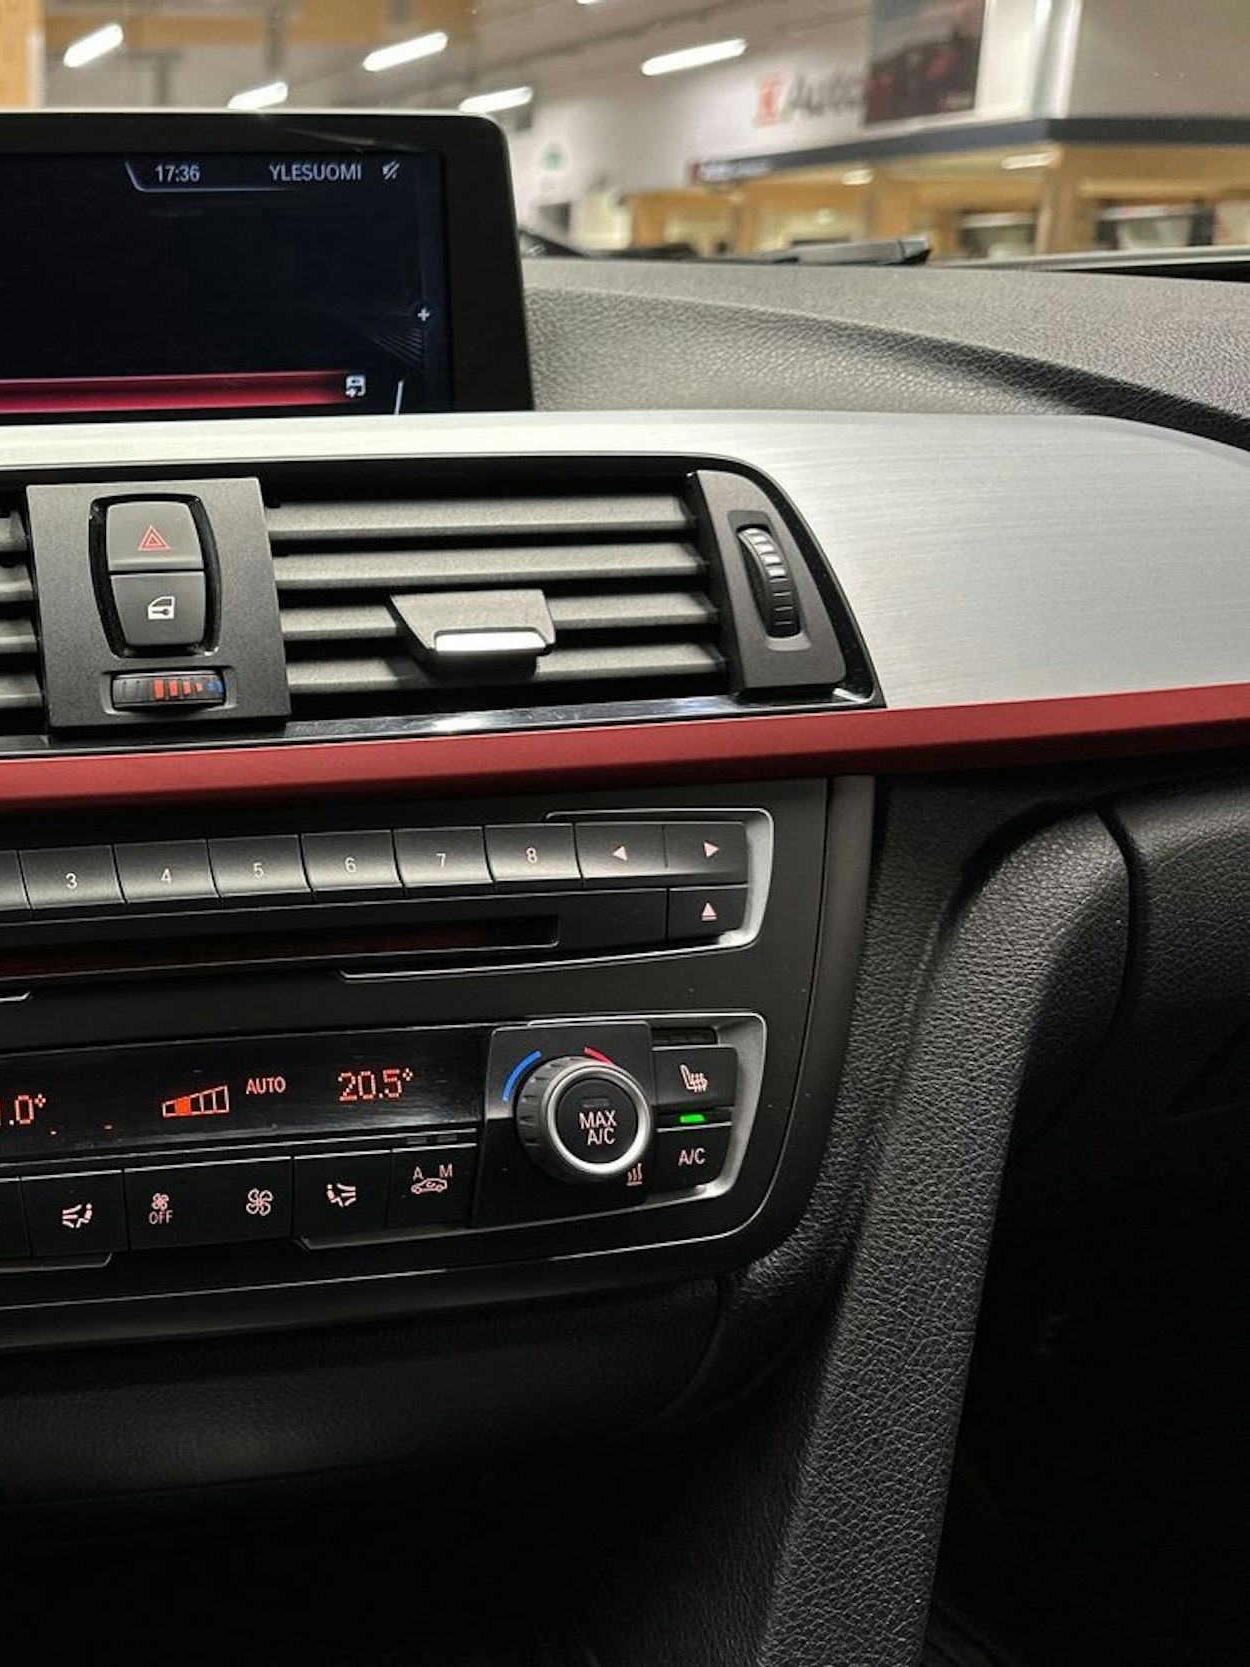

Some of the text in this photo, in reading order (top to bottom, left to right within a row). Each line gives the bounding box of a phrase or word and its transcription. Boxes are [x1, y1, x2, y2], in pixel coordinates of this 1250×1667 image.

[155, 164, 200, 182] 17:36
[269, 163, 362, 181] YLESUOMI
[436, 853, 447, 869] 7
[526, 847, 538, 864] 8
[253, 862, 265, 879] 5
[345, 857, 357, 874] 6
[66, 873, 78, 890] 3
[160, 867, 174, 884] 4
[245, 1076, 287, 1095] AUTO
[579, 1109, 618, 1129] MAX
[586, 1126, 616, 1146] A/C
[678, 1147, 706, 1167] A/C
[412, 1164, 453, 1179] A M
[148, 1209, 173, 1225] OFF
